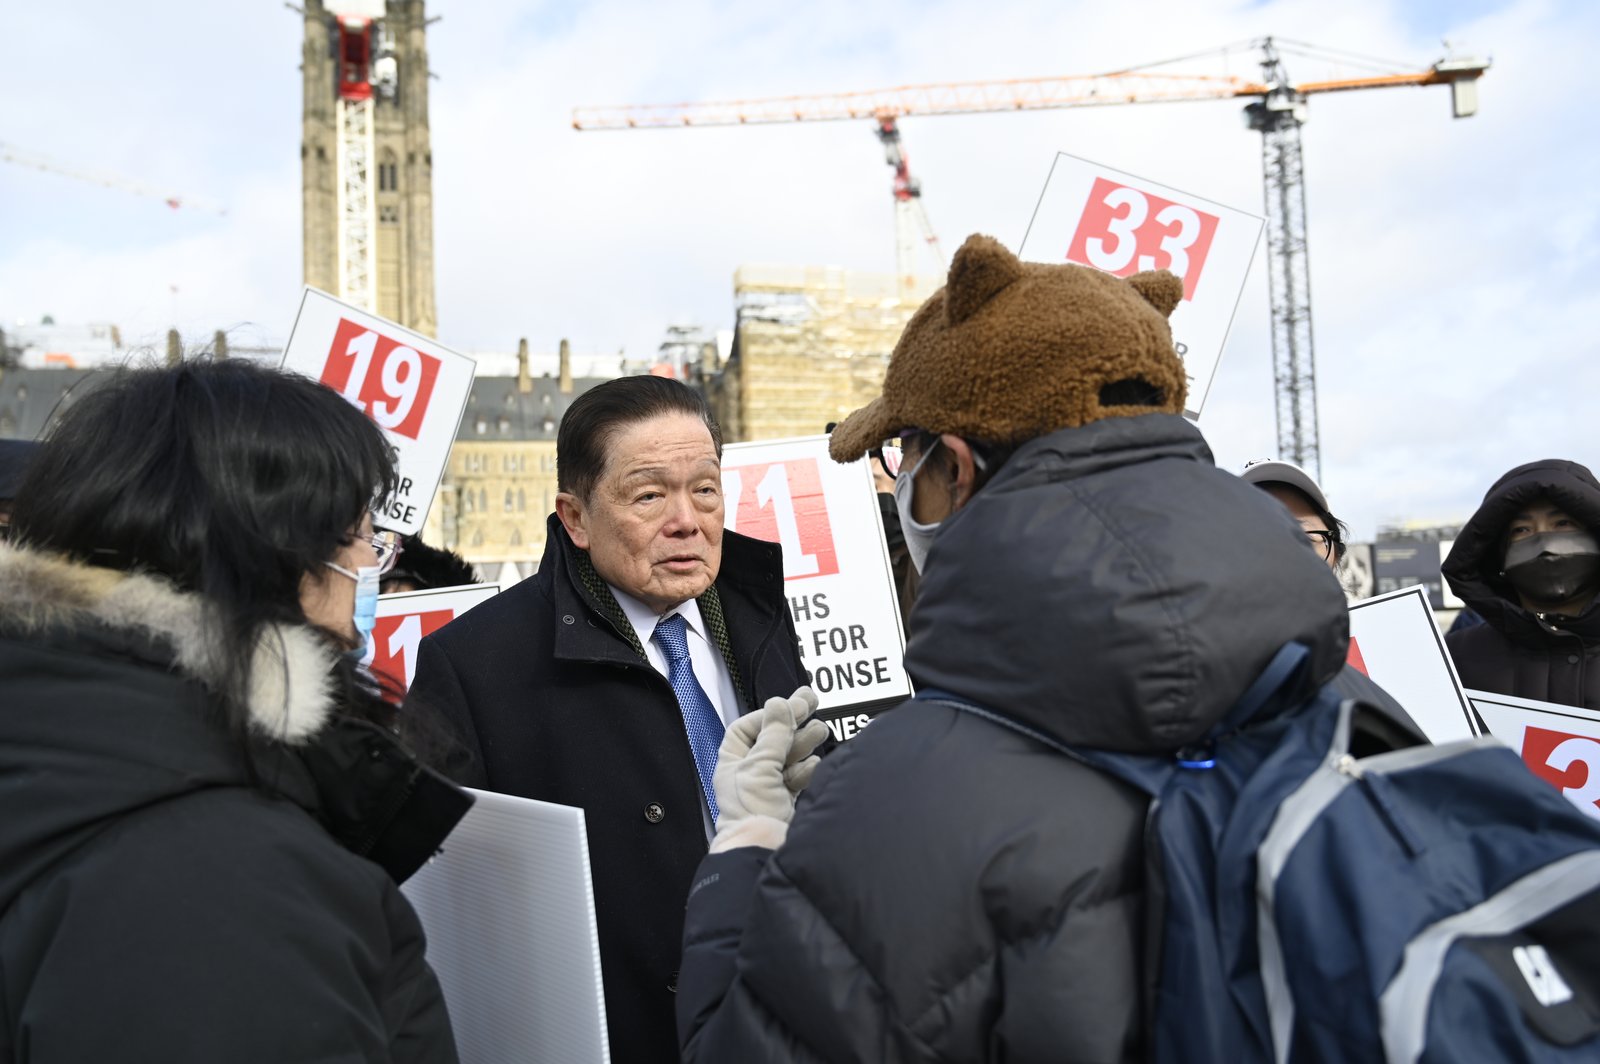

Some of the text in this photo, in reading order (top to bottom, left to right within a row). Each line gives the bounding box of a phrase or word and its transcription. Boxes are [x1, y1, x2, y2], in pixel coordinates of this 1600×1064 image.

[1085, 187, 1201, 281] 33
[334, 330, 422, 429] 19
[812, 624, 868, 656] FOR
